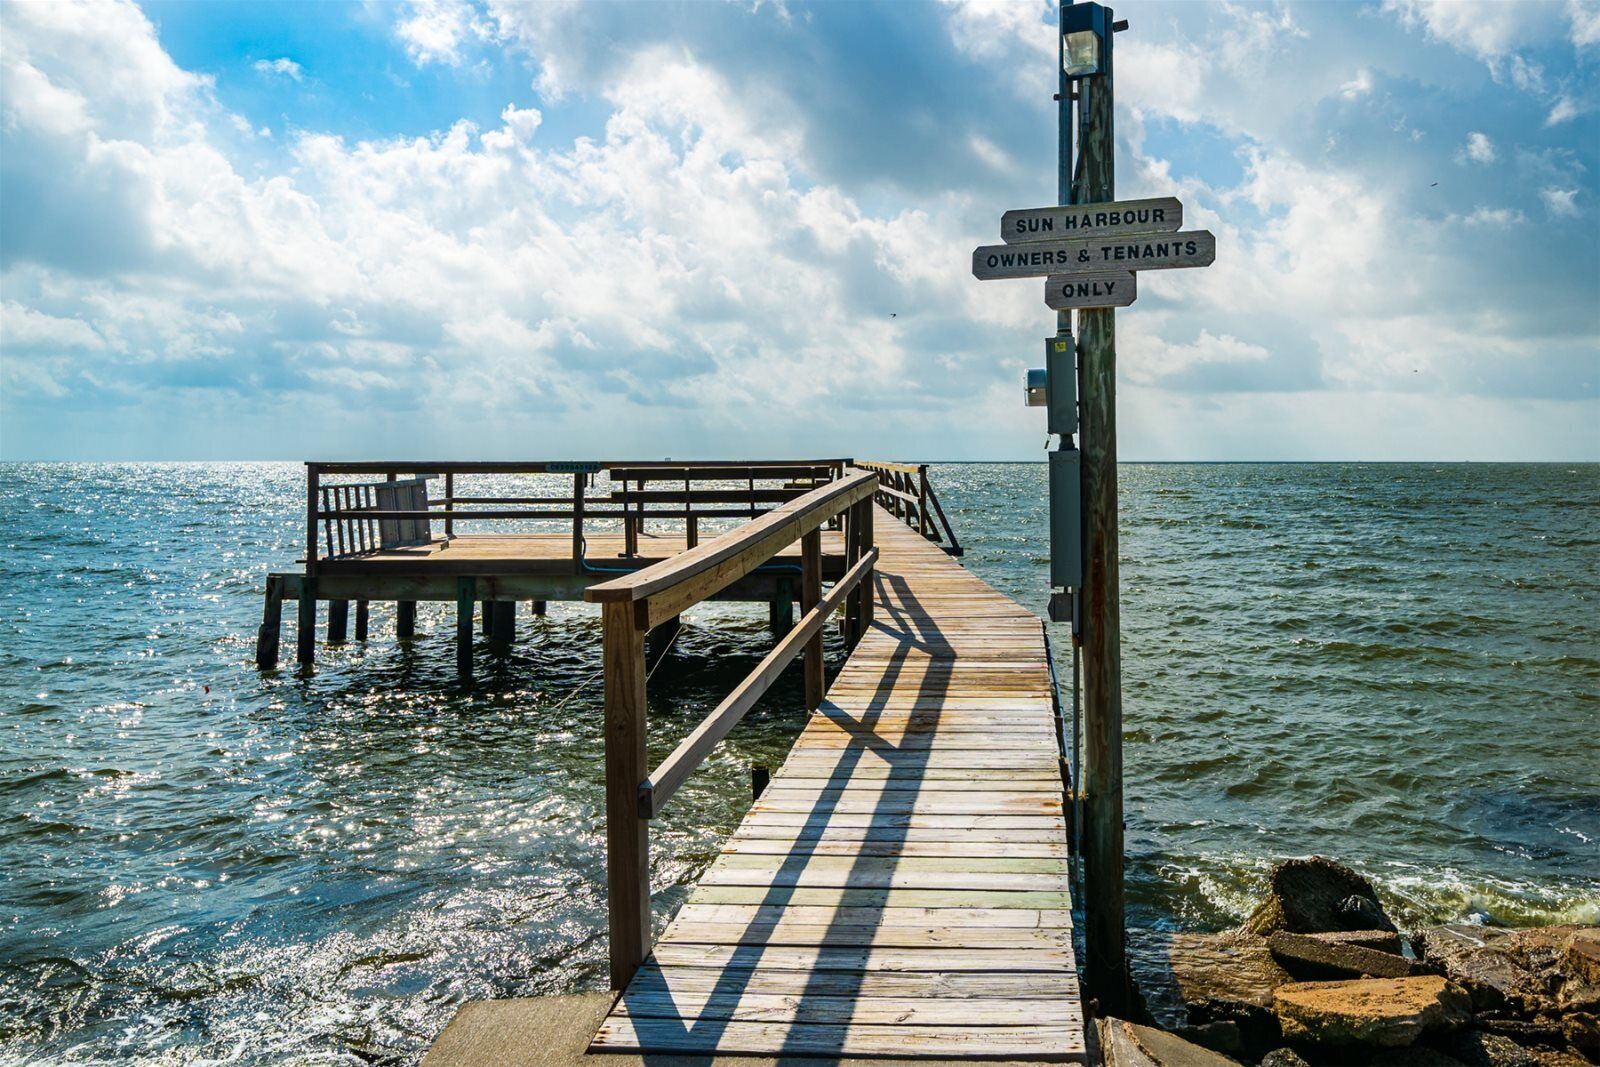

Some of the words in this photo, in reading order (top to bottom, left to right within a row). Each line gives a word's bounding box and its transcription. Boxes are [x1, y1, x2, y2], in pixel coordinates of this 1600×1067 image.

[1016, 217, 1053, 233] SUN
[1065, 208, 1165, 230] HARBOUR
[987, 250, 1067, 268] OWNERS
[1078, 249, 1090, 263] &
[1101, 241, 1197, 260] TENANTS
[1062, 282, 1115, 298] ONLY
